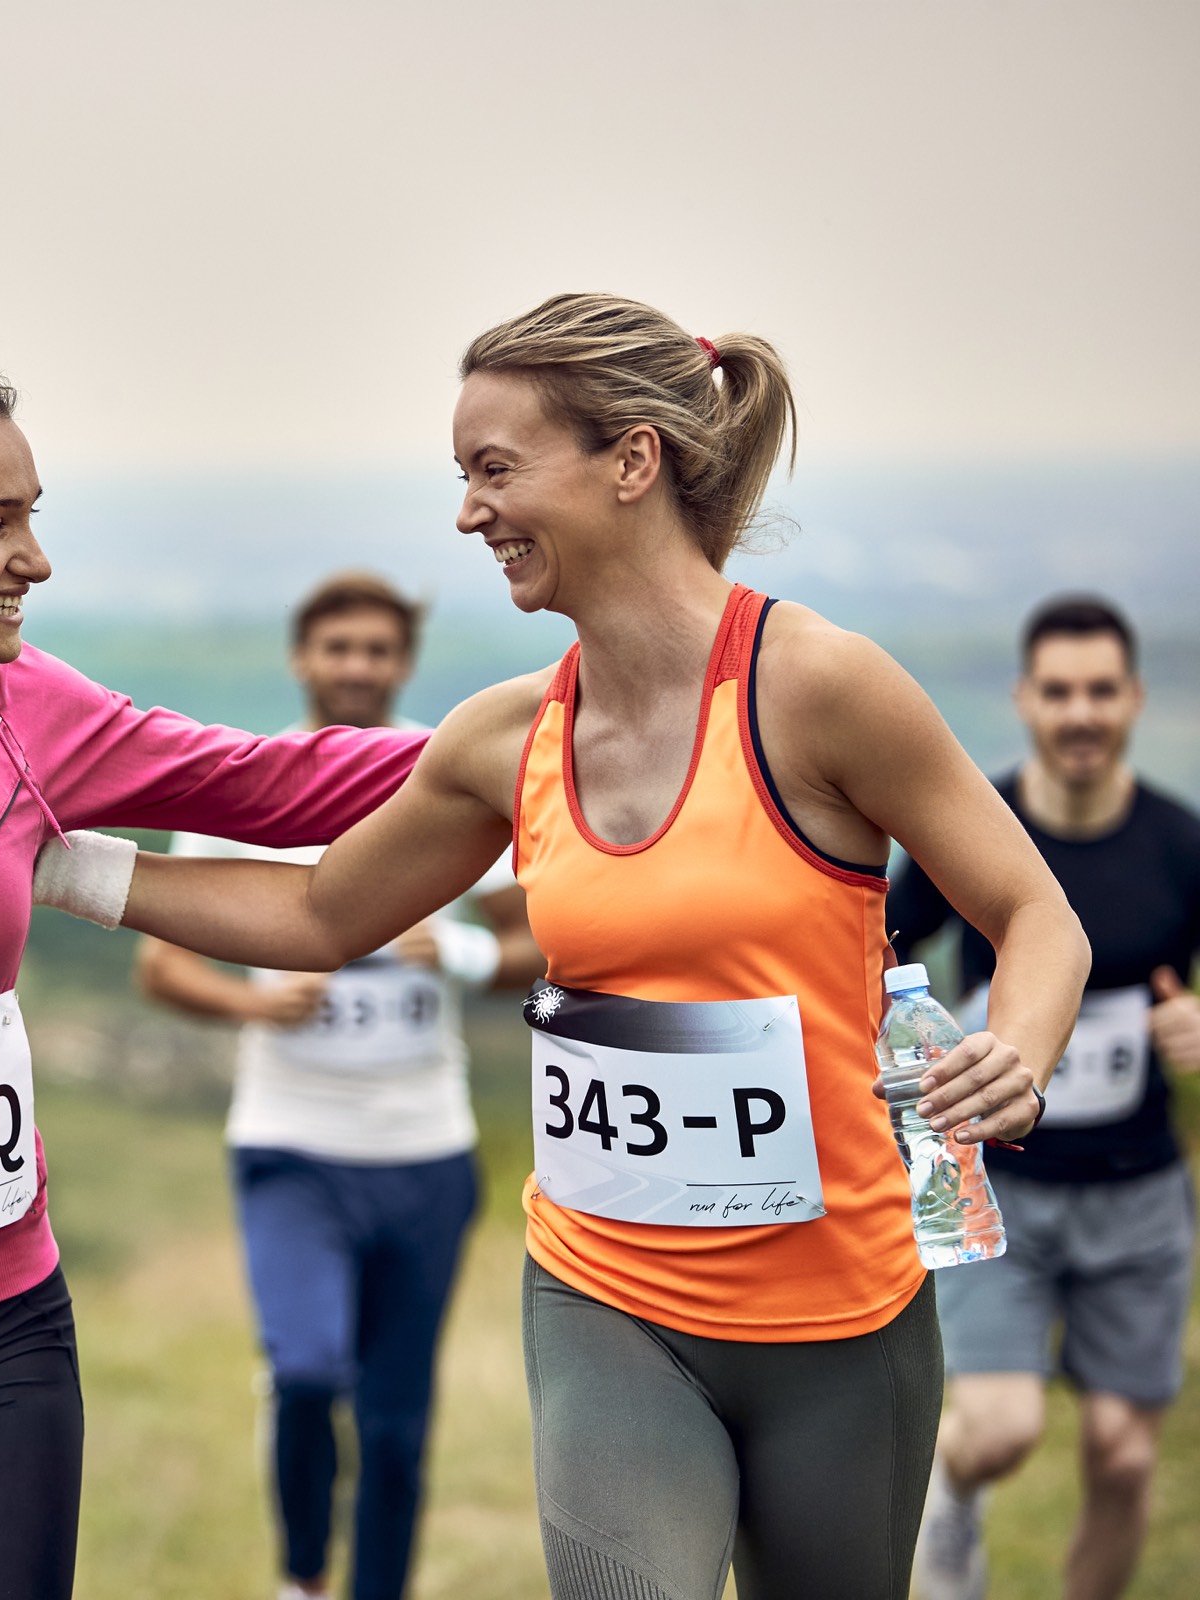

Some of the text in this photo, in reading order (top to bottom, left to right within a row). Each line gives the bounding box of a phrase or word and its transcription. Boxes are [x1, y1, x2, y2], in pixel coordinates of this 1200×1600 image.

[545, 1064, 787, 1158] 343-P
[1, 1186, 26, 1215] life
[689, 1187, 800, 1219] run for life
